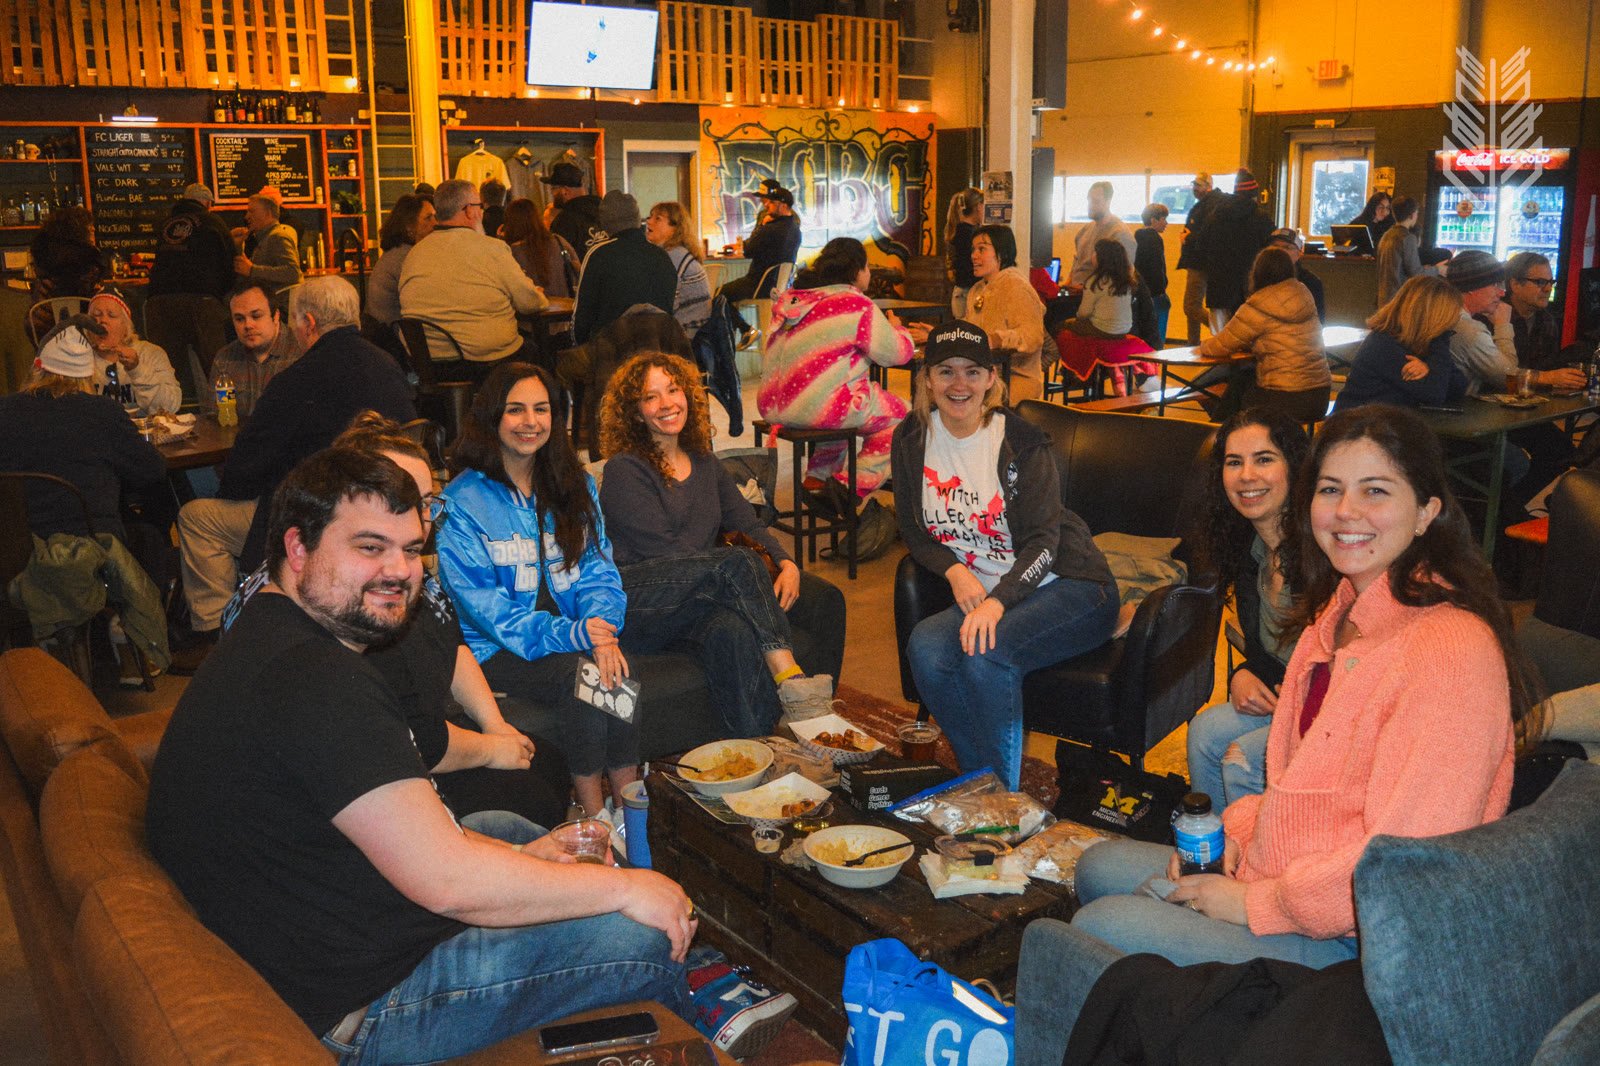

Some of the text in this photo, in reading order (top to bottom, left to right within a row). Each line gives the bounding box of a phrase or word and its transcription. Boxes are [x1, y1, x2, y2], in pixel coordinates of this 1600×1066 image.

[1319, 60, 1339, 78] EXIT
[109, 132, 134, 142] LAGER
[1499, 155, 1518, 164] ICE
[1519, 154, 1551, 164] COLD
[115, 178, 139, 187] DARK
[937, 486, 979, 506] WITCH
[1100, 786, 1140, 816] M
[1098, 806, 1129, 820] MICHIN
